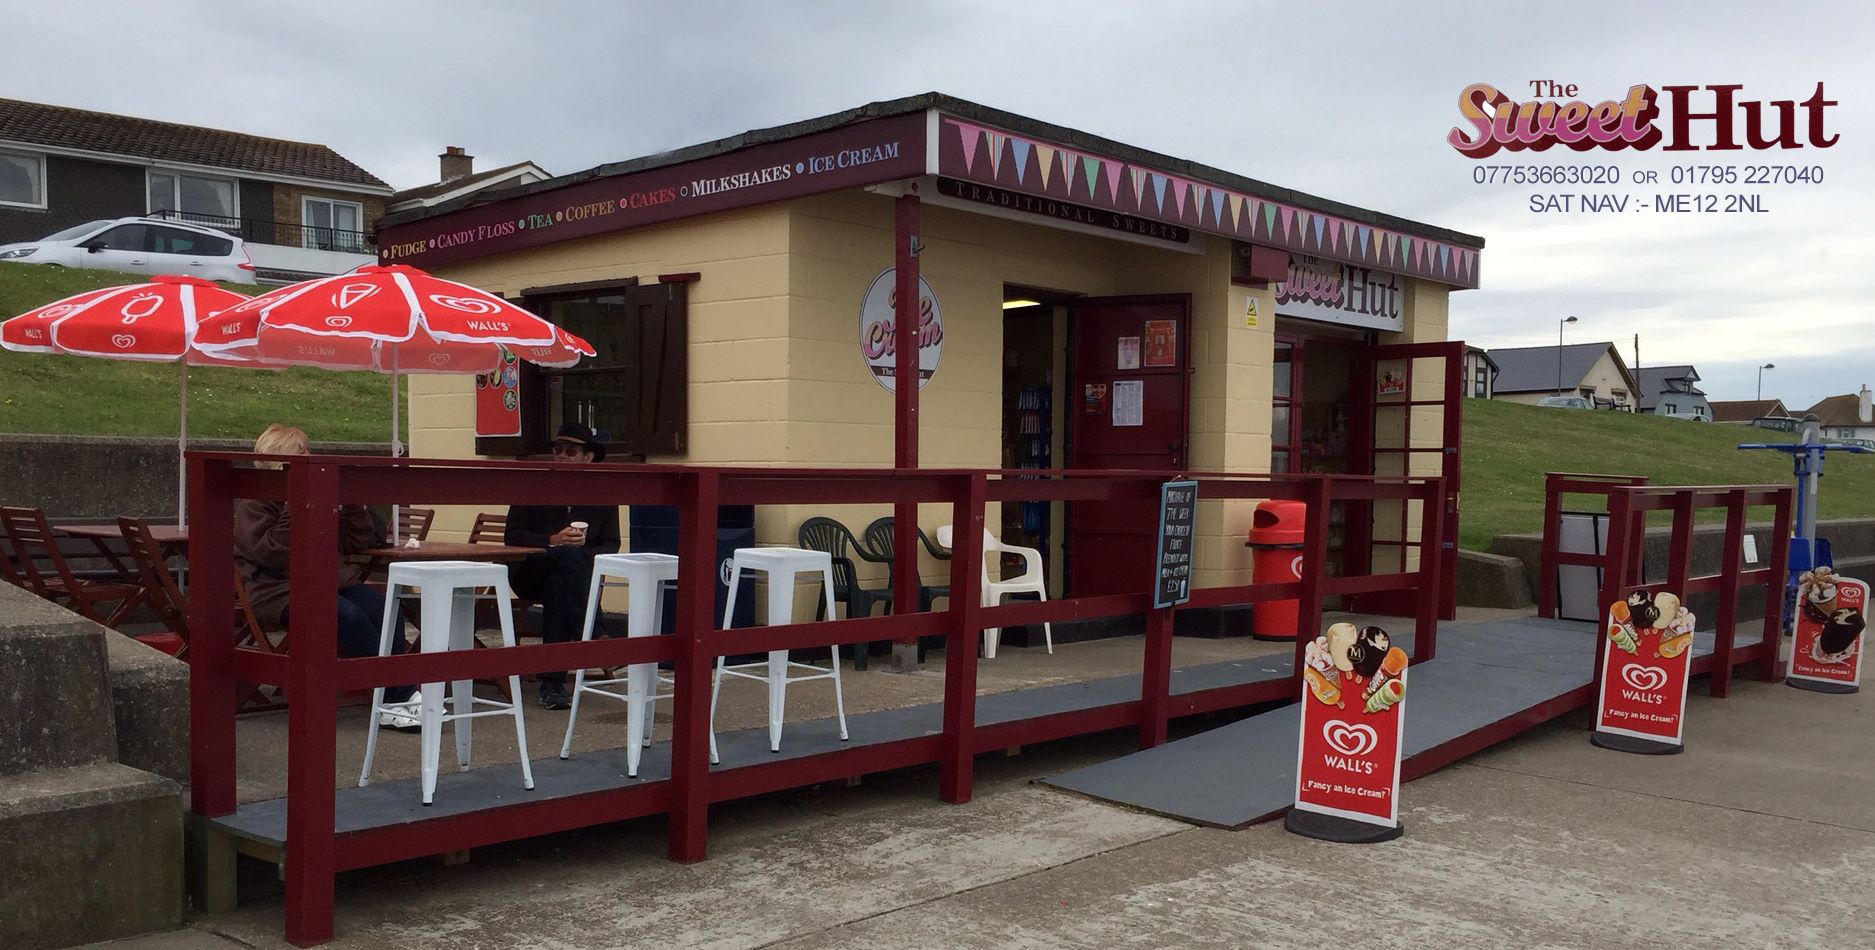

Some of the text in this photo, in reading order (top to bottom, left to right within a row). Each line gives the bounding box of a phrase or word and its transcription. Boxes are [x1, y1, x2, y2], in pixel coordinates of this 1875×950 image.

[390, 142, 900, 259] FUDGE CANDY FLOSS TEA COFFEE CAKES MILKSHAKES ICE CREAM
[955, 181, 1178, 240] TRADITIONAL SWEETS
[1344, 264, 1399, 319] Hut
[221, 322, 241, 335] WALL'S
[467, 320, 509, 332] WALL'S
[1350, 647, 1362, 658] M
[1622, 689, 1663, 705] WALL'S
[1324, 754, 1373, 775] WALL'S
[1308, 780, 1386, 799] Fancy an Ice Cream?
